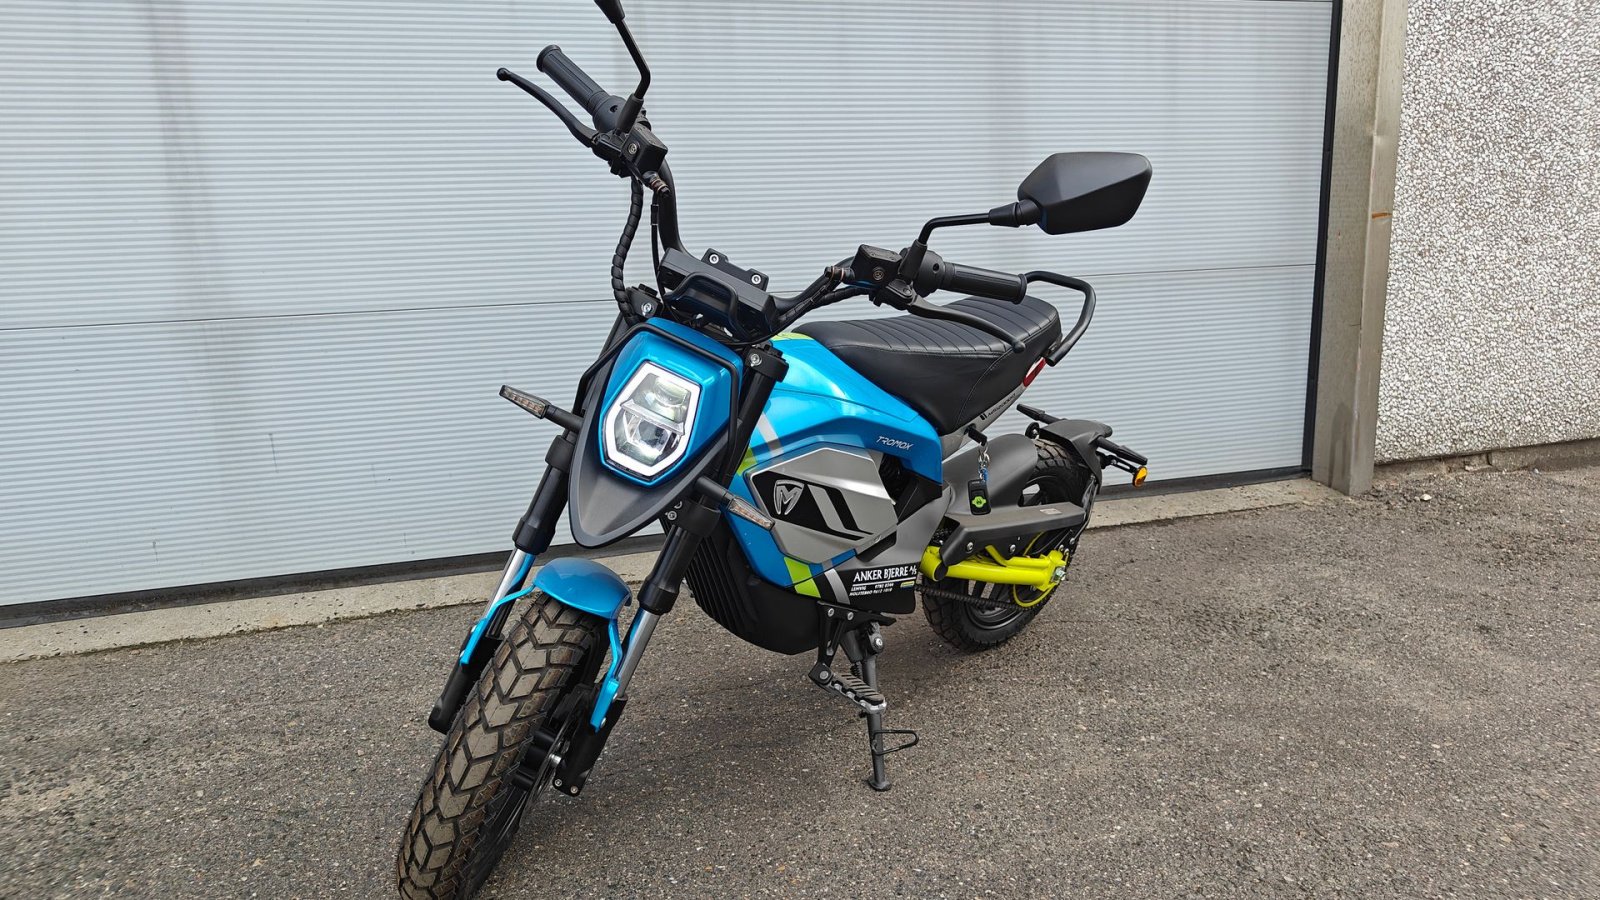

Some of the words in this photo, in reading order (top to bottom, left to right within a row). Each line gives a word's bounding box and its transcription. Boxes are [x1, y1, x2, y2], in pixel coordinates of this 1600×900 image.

[876, 435, 914, 450] TROMOX
[853, 569, 882, 582] ANKER
[884, 566, 909, 579] BJERRE
